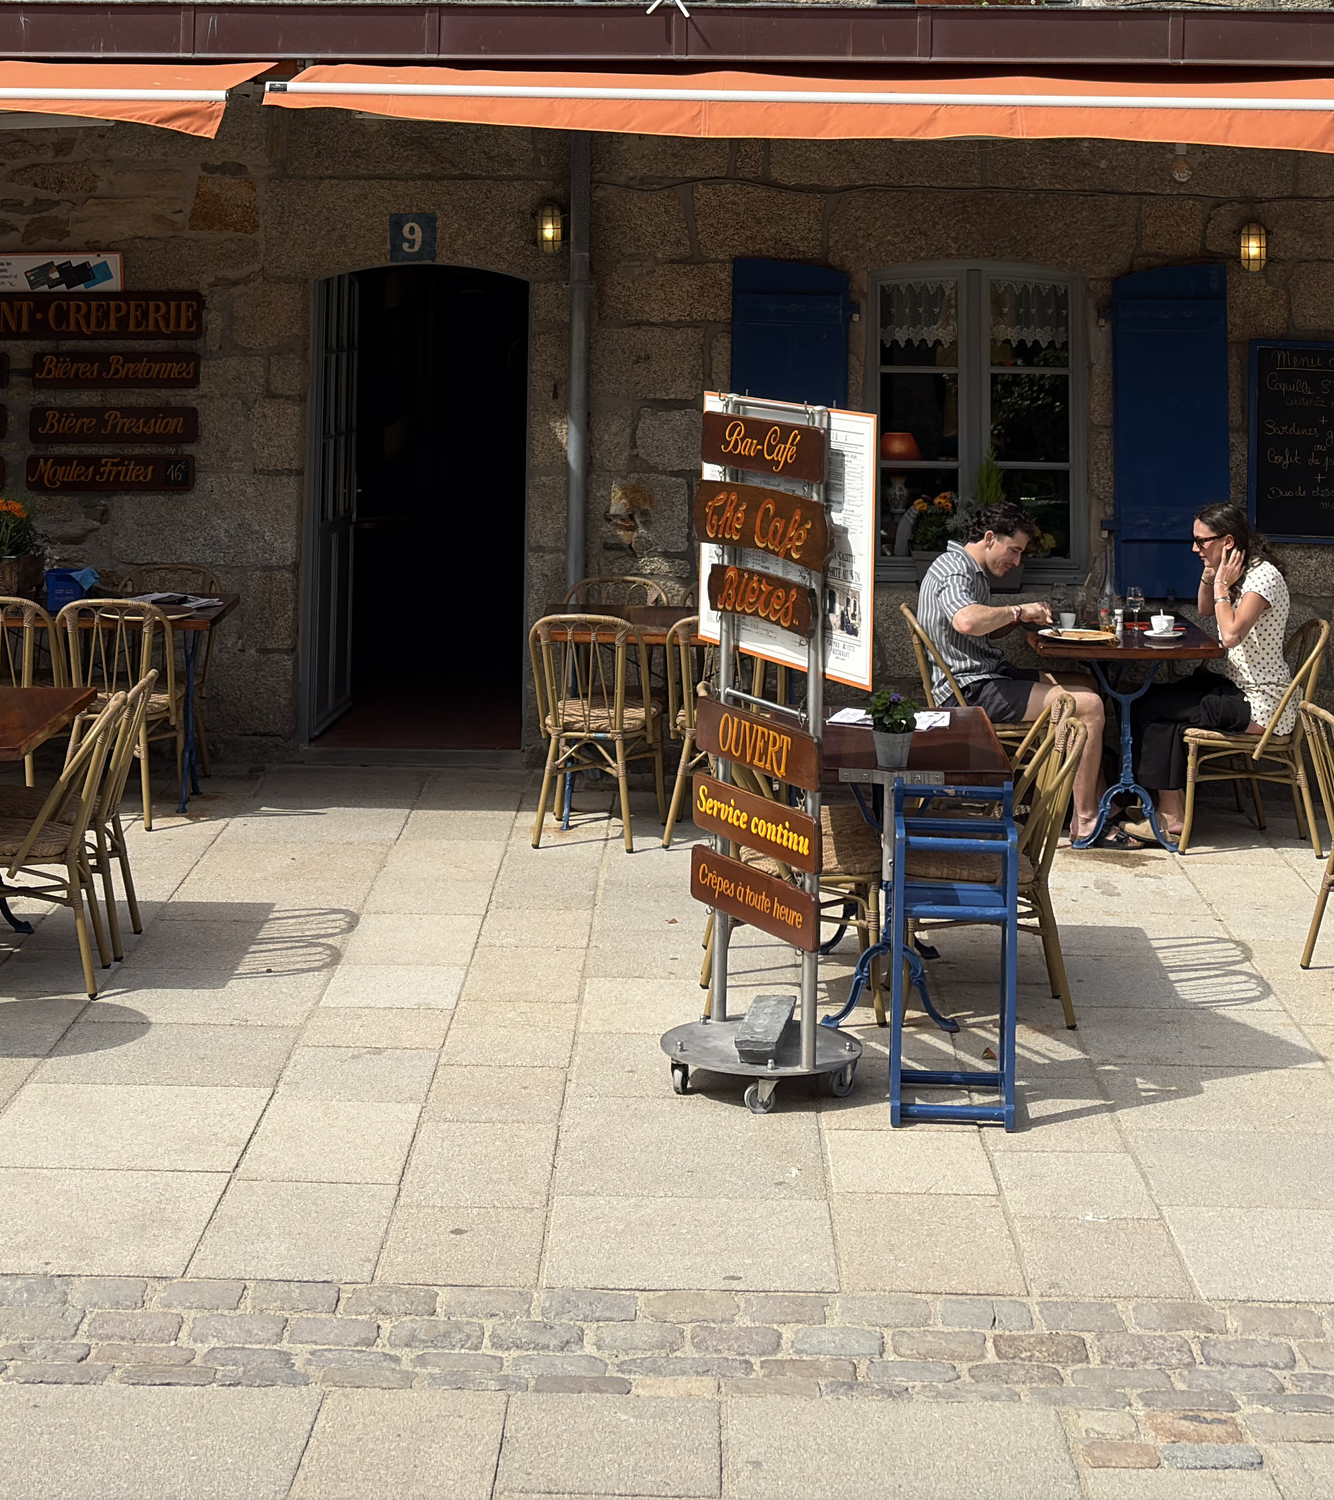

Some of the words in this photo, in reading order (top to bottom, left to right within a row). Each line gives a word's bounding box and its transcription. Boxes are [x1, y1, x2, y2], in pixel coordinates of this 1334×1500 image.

[402, 222, 423, 253] 9
[48, 300, 199, 335] CREPERIE
[36, 355, 100, 379] Bières
[102, 355, 195, 379] Bretonnes
[1271, 349, 1322, 368] Menu
[1266, 371, 1316, 397] Coquille
[38, 410, 97, 434] Bière
[101, 410, 185, 435] Pression
[1264, 419, 1320, 438] Sardines
[721, 421, 801, 472] Bar-Café
[1267, 447, 1302, 469] Confit
[1307, 451, 1321, 466] de
[28, 458, 96, 488] Moules
[95, 458, 155, 482] Frites
[705, 491, 747, 541] Thé
[754, 498, 812, 560] Café
[718, 712, 792, 779] OUVERT
[697, 784, 748, 830] Service
[750, 816, 810, 856] continu
[699, 863, 735, 900] Crêpes
[736, 881, 745, 903] à
[745, 888, 772, 914] toute
[772, 902, 803, 930] heure
